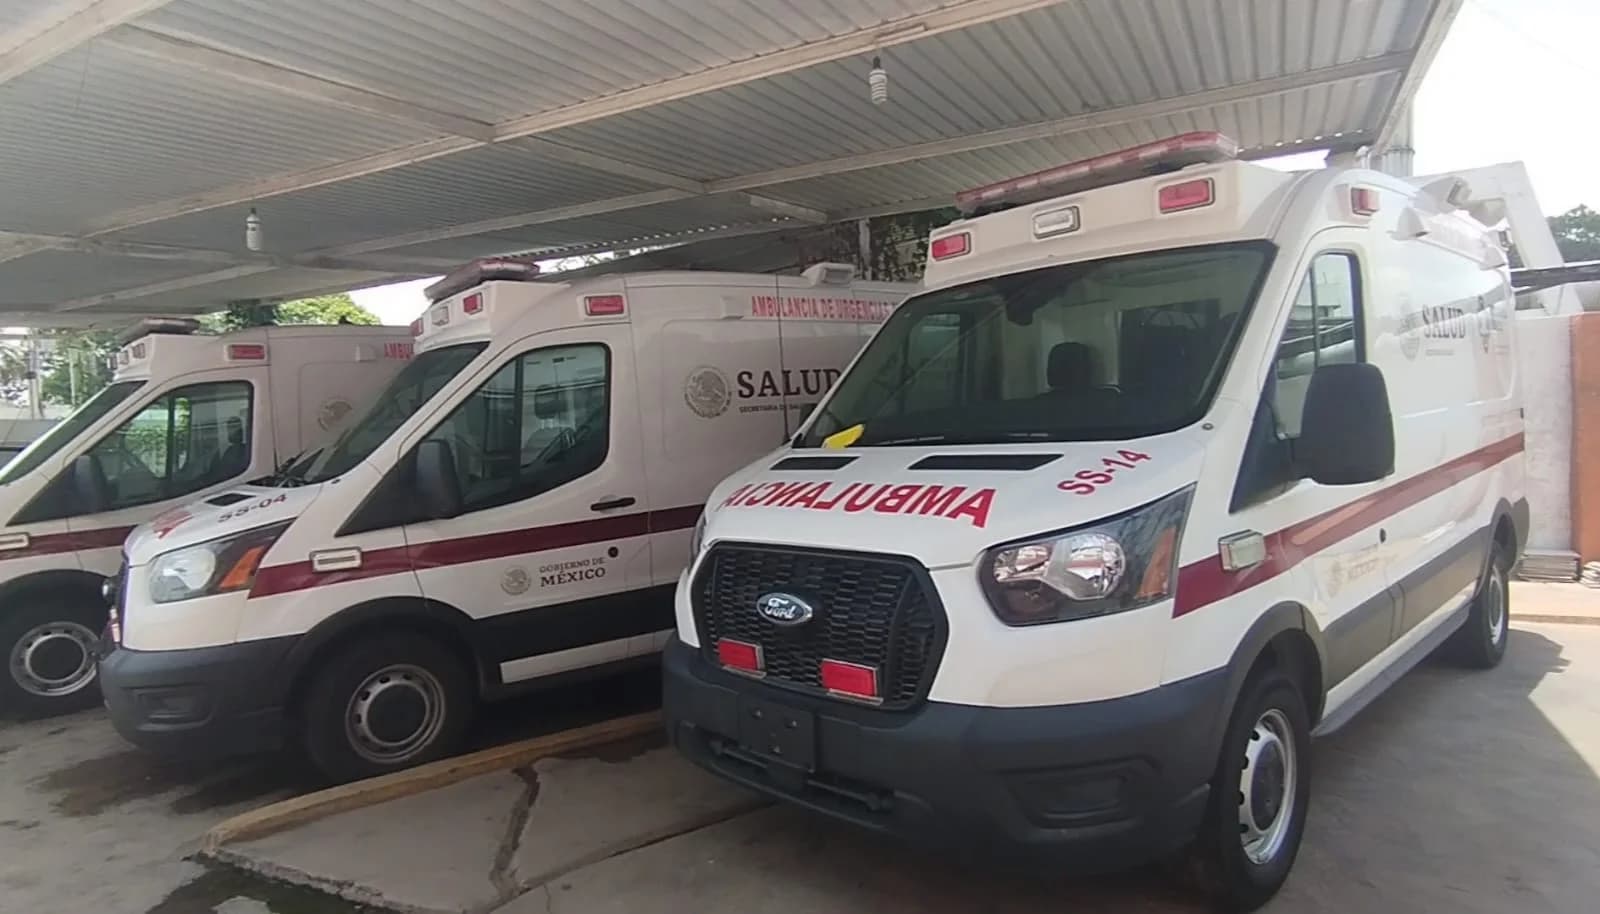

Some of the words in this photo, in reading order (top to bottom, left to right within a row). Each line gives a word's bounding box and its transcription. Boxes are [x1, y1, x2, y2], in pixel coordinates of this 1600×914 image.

[751, 295, 819, 318] AMBULANCIA
[820, 298, 835, 319] DE
[1421, 304, 1467, 339] SALUD
[1057, 449, 1153, 496] SS-14
[217, 493, 287, 523] SS-04
[539, 559, 590, 573] GOBIERNO
[591, 557, 605, 566] DE
[540, 567, 606, 588] MÉXICO
[764, 597, 797, 620] Ford
